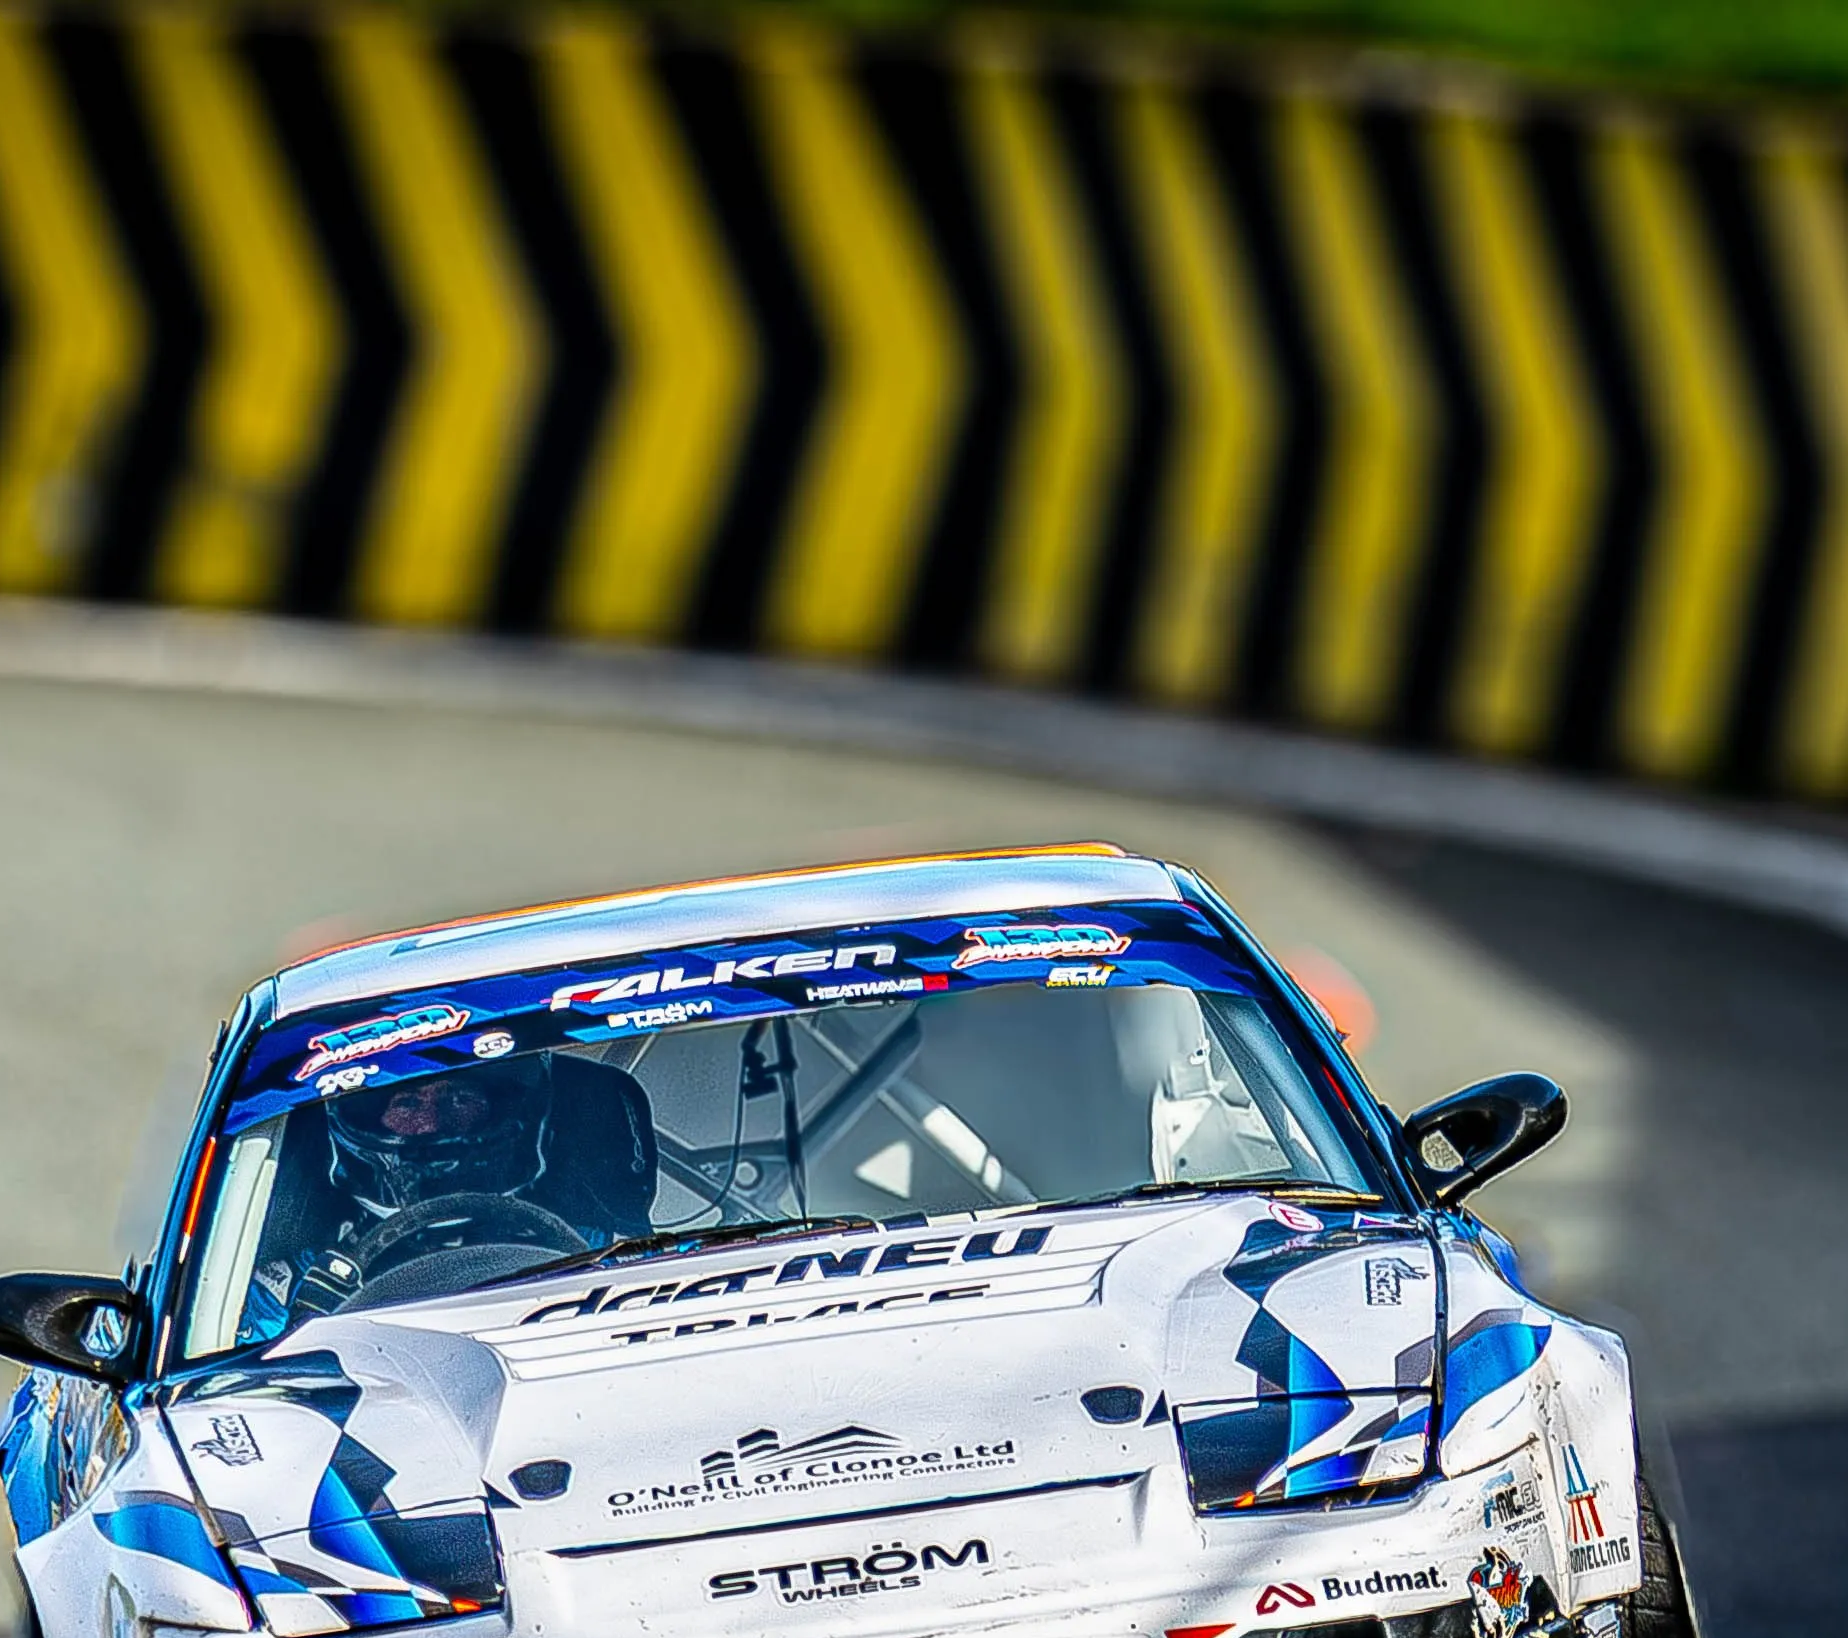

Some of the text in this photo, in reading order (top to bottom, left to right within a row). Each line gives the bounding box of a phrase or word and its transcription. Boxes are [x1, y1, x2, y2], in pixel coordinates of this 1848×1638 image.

[550, 944, 896, 1011] FALKEN
[806, 977, 923, 1001] HEATWAVE
[607, 1440, 1015, 1507] O'Neill of Clonoe Ltd
[612, 1498, 696, 1518] Building
[722, 1485, 767, 1500] Civil
[773, 1470, 894, 1494] Engineering
[899, 1457, 1016, 1477] Contractors
[708, 1540, 990, 1600] STRÖM
[782, 1575, 922, 1603] WHEELS
[1321, 1566, 1448, 1601] Budmat.
